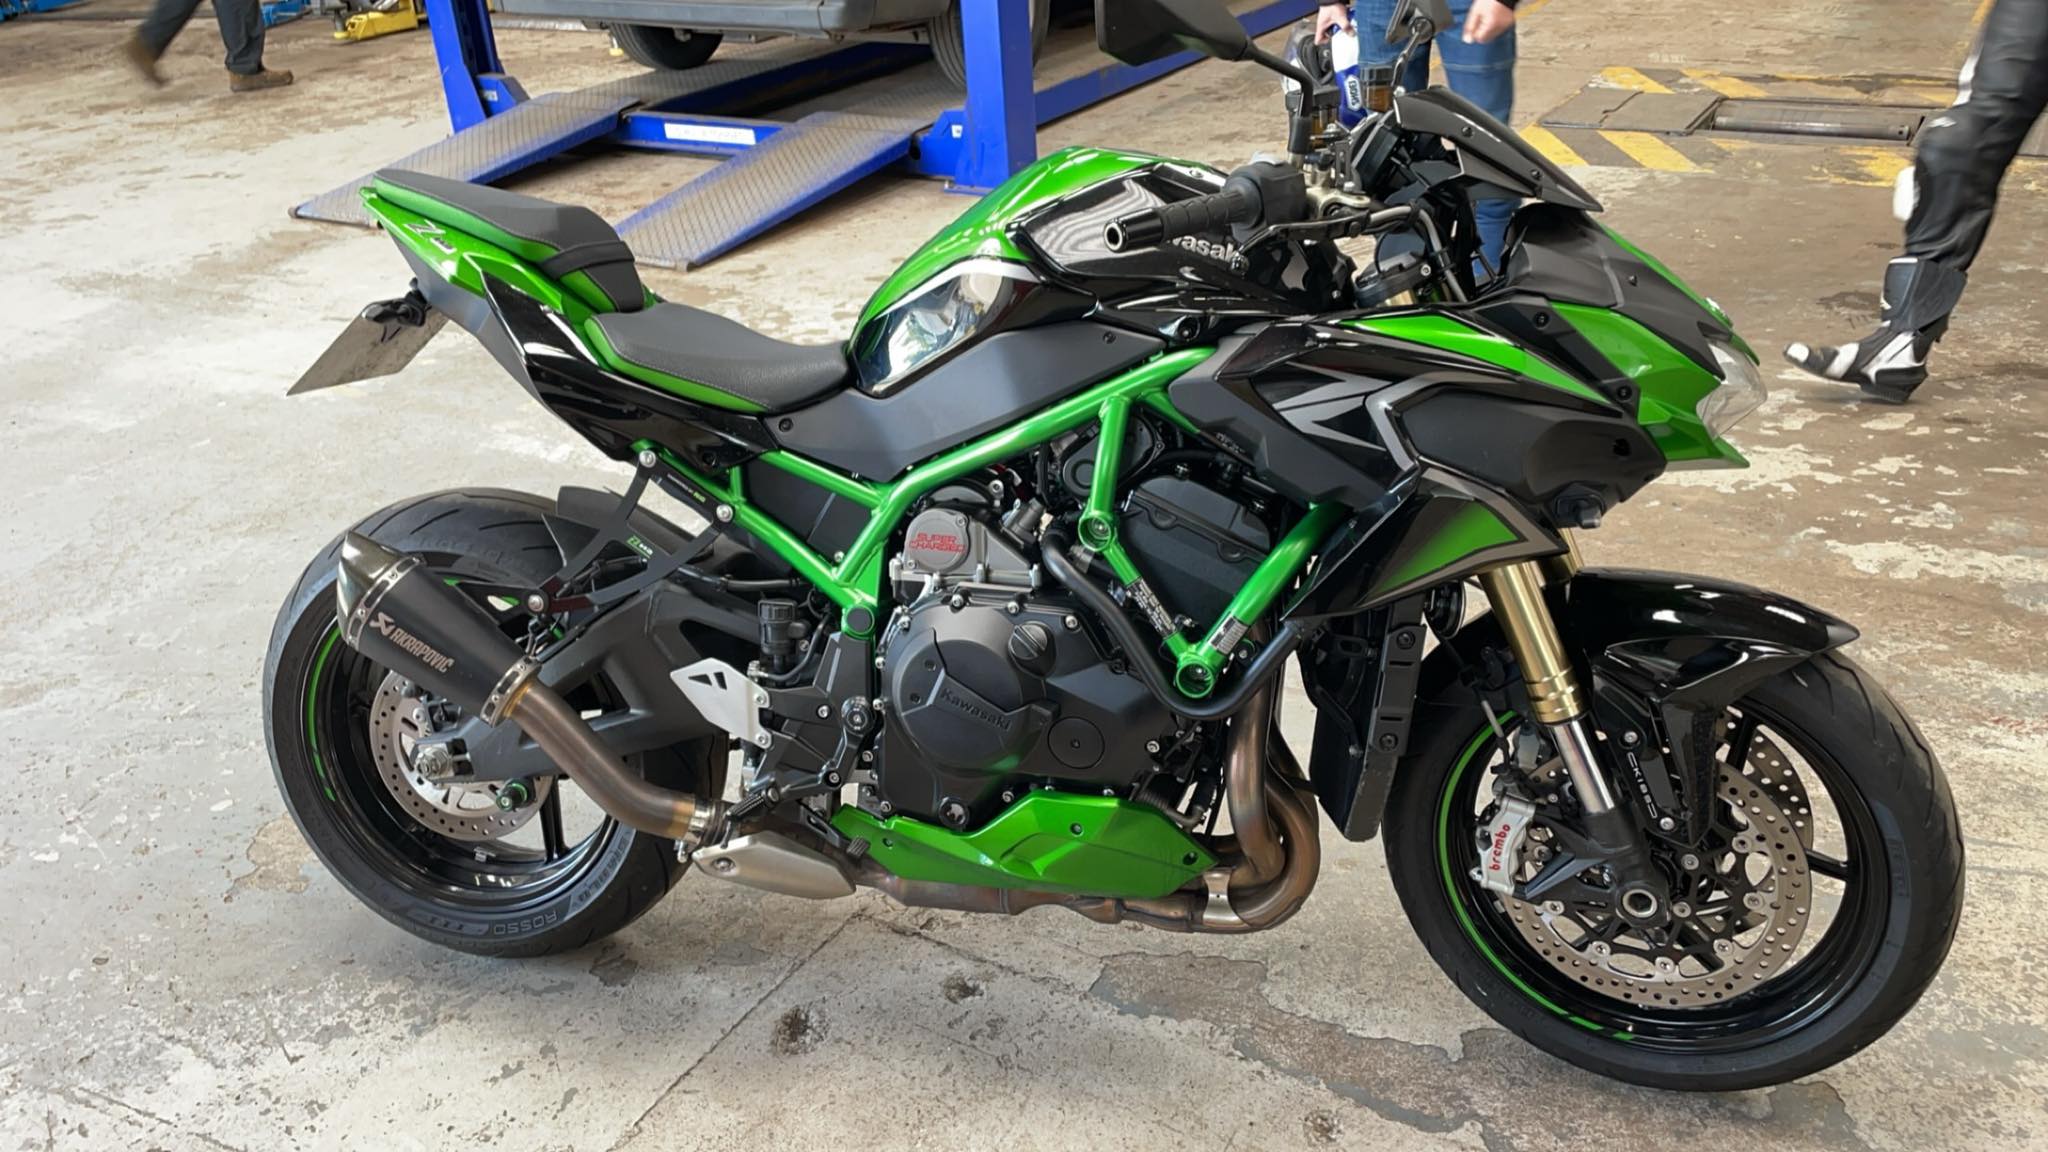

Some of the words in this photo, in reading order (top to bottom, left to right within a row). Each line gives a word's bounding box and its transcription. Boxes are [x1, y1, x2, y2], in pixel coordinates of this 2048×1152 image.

[916, 532, 957, 545] SUPER
[940, 688, 1012, 732] Kawasaki
[1488, 823, 1511, 872] brembo
[493, 910, 558, 936] ROSSO
